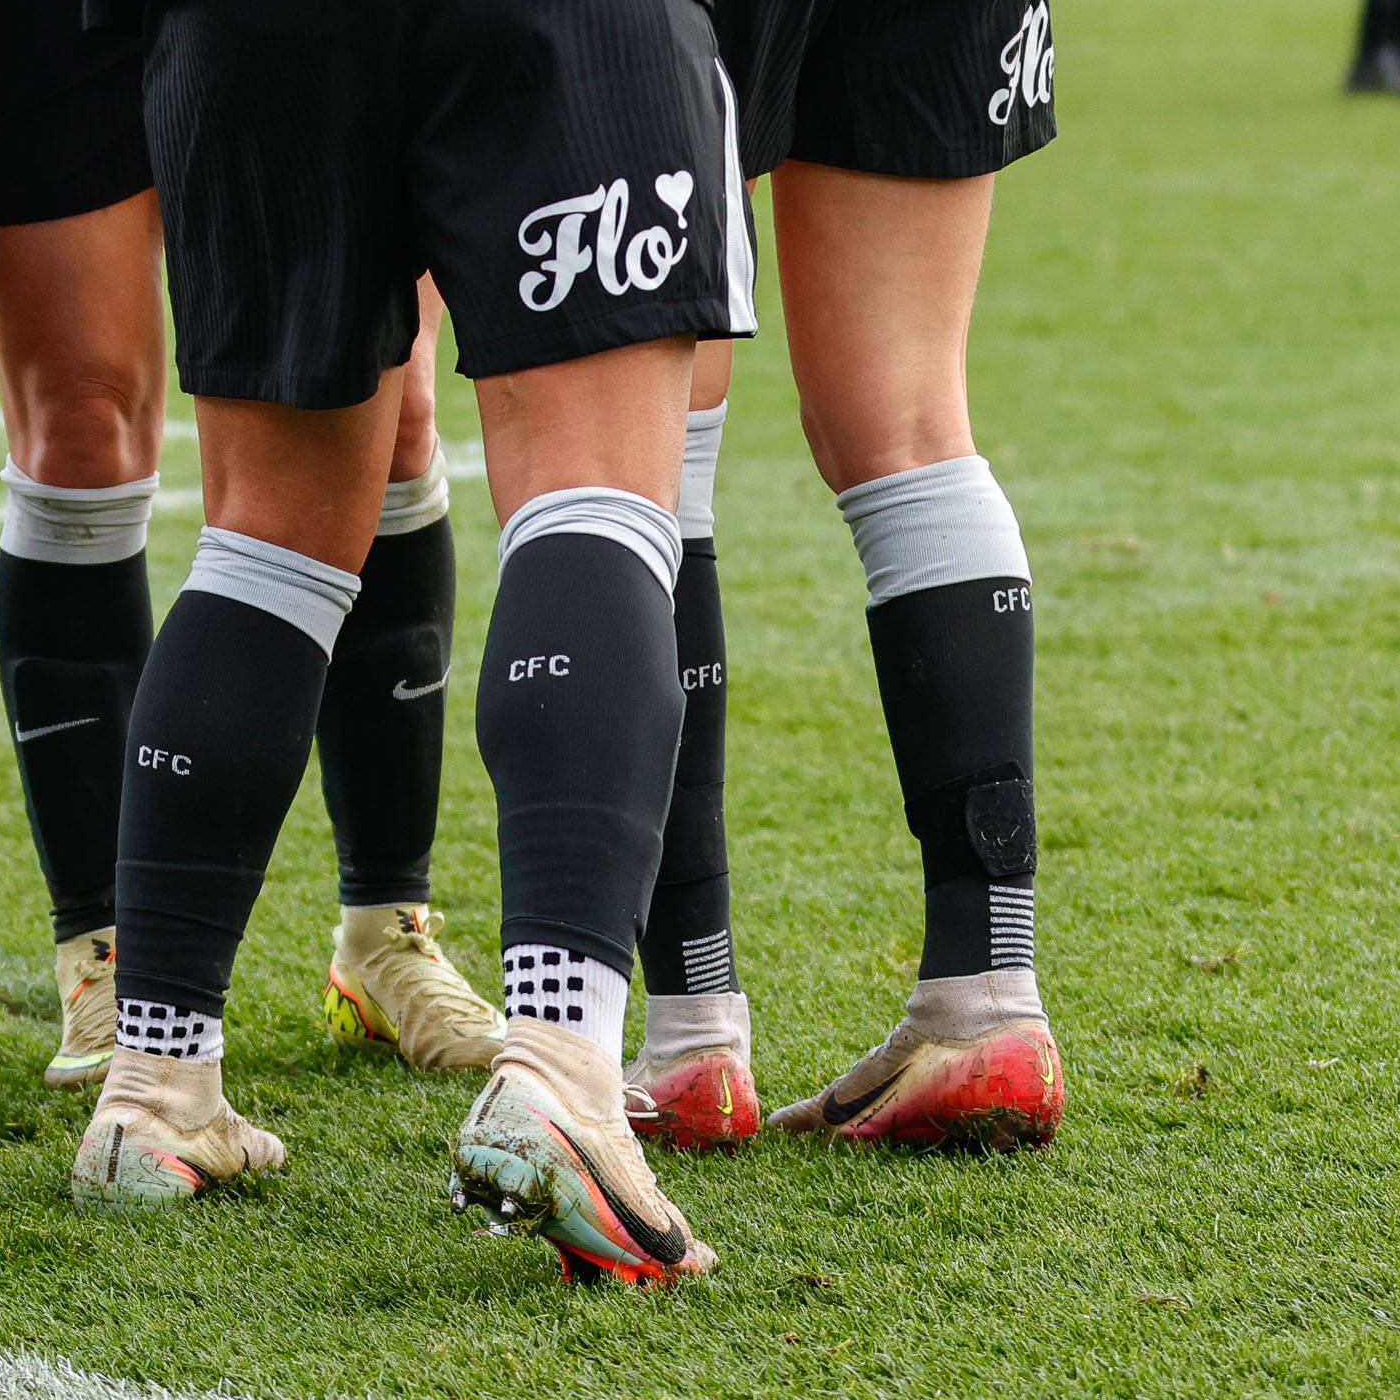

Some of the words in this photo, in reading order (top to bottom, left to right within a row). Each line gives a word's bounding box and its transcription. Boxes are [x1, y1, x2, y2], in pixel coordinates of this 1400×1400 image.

[518, 177, 688, 312] Flo
[992, 586, 1031, 613] CFC
[508, 654, 570, 681] CFC
[683, 662, 722, 690] CFC
[137, 745, 192, 776] CFC
